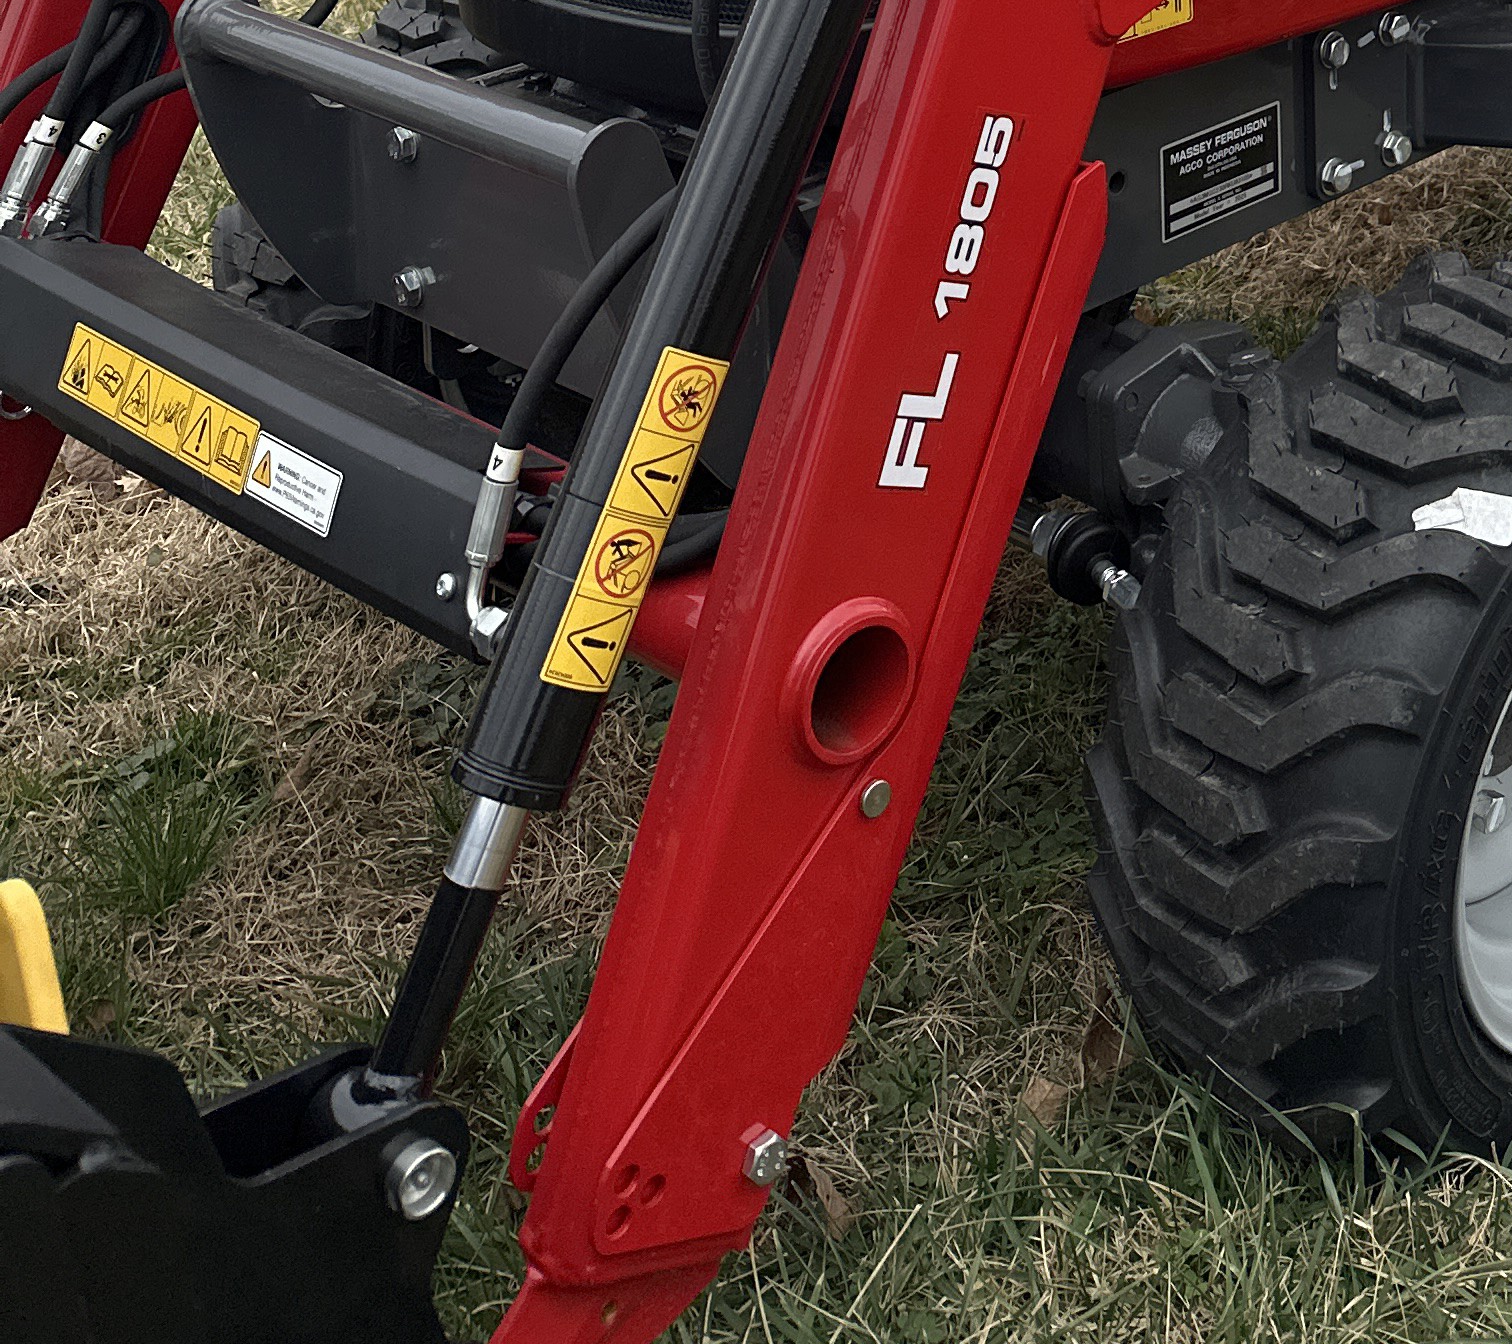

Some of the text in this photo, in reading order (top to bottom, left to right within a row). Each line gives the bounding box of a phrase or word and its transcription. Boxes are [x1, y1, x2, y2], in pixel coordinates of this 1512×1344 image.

[48, 125, 58, 138] 4
[96, 132, 107, 145] 3
[1170, 138, 1213, 166] MASSEY
[1214, 116, 1268, 147] FERGUSON
[1179, 158, 1204, 177] AGCO
[1205, 133, 1264, 164] CORPORATION
[877, 115, 1014, 489] FL 1805
[493, 454, 504, 471] 4
